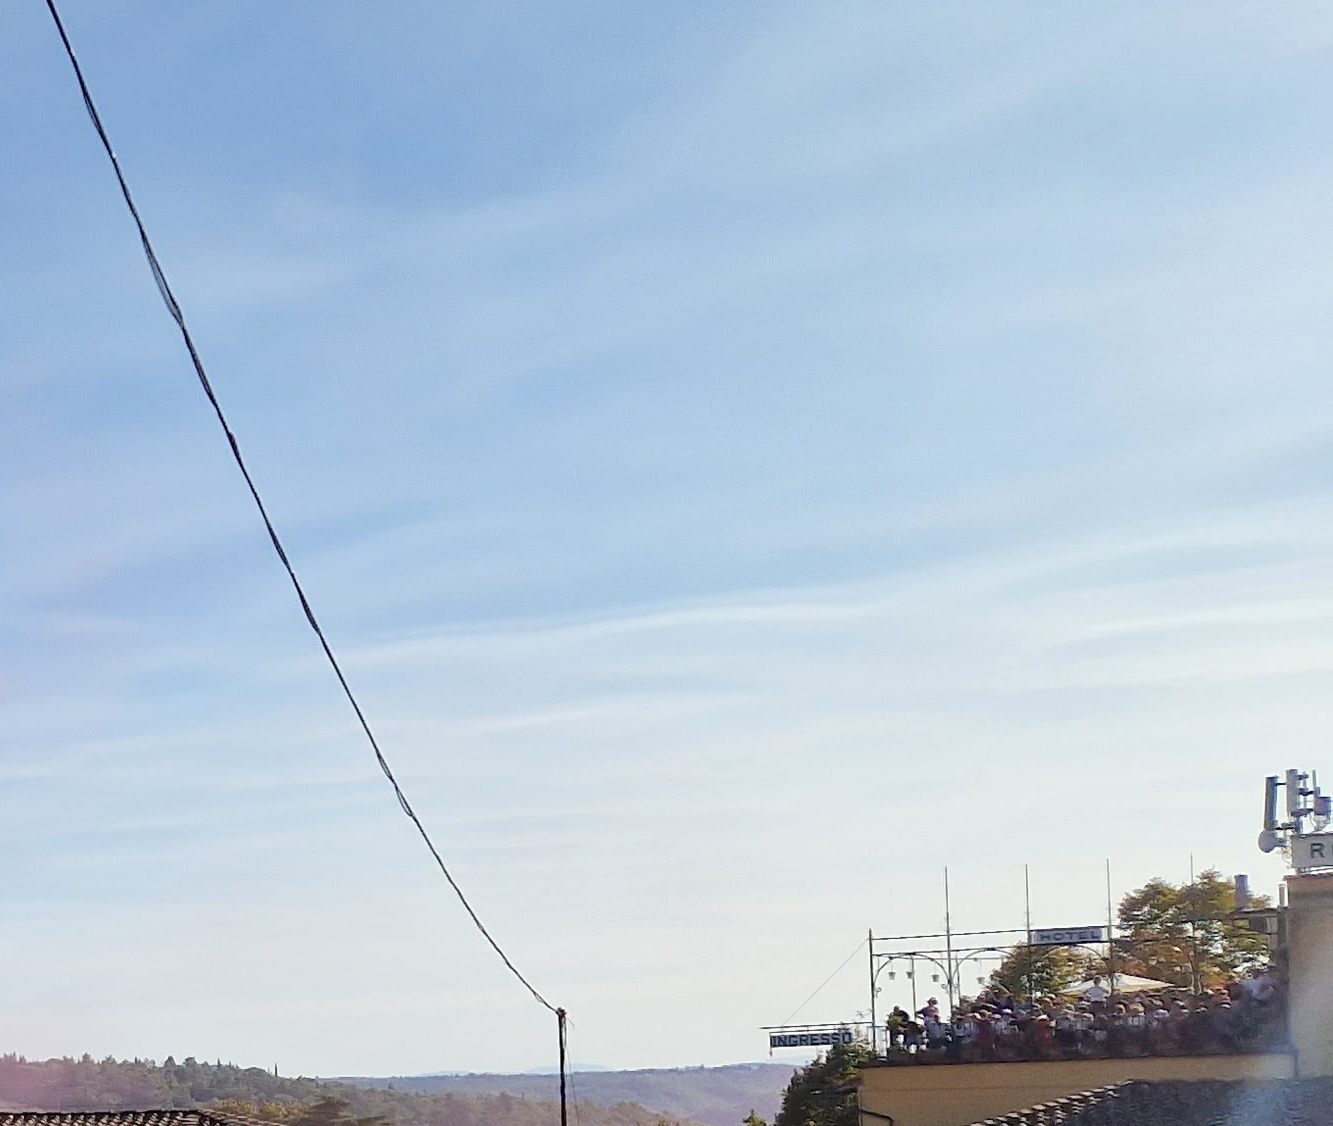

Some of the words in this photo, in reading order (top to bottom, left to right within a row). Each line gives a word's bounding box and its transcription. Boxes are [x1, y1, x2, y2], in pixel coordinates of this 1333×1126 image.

[1310, 842, 1333, 859] R
[1039, 930, 1100, 941] HOTEL
[773, 1032, 852, 1047] INGRESSO
